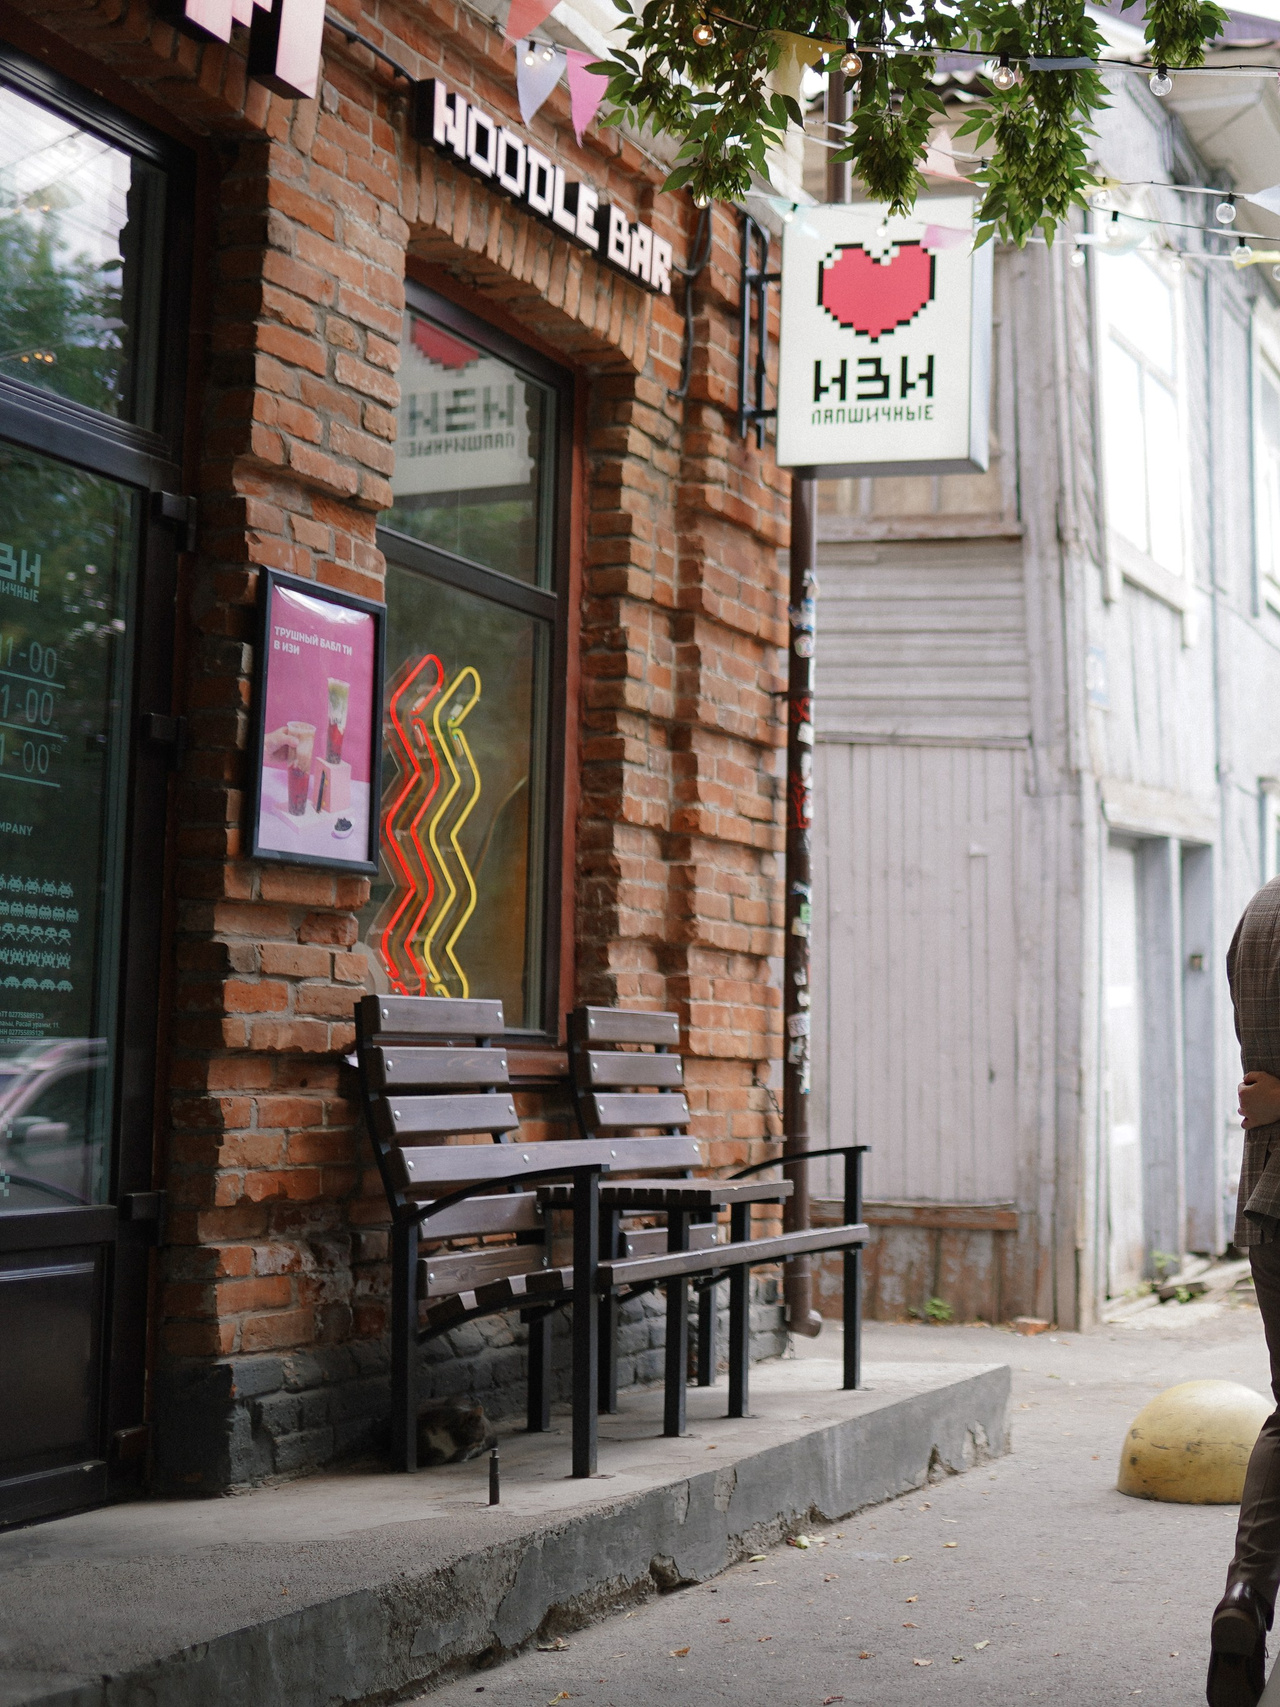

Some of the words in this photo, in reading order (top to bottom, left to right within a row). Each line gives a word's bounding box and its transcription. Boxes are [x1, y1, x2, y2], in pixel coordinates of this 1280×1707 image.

[433, 77, 599, 251] NOODLE
[607, 203, 673, 296] BAR
[813, 354, 934, 402] ИЗИ
[812, 404, 934, 425] ЛАПШИЧНЫЕ
[0, 580, 39, 603] ИЧНЫЕ
[273, 639, 281, 651] В
[281, 641, 300, 656] ИЗИ
[274, 625, 320, 647] ТРУШНЫЙ
[319, 637, 342, 654] БАБЛ
[342, 644, 354, 656] ТИ
